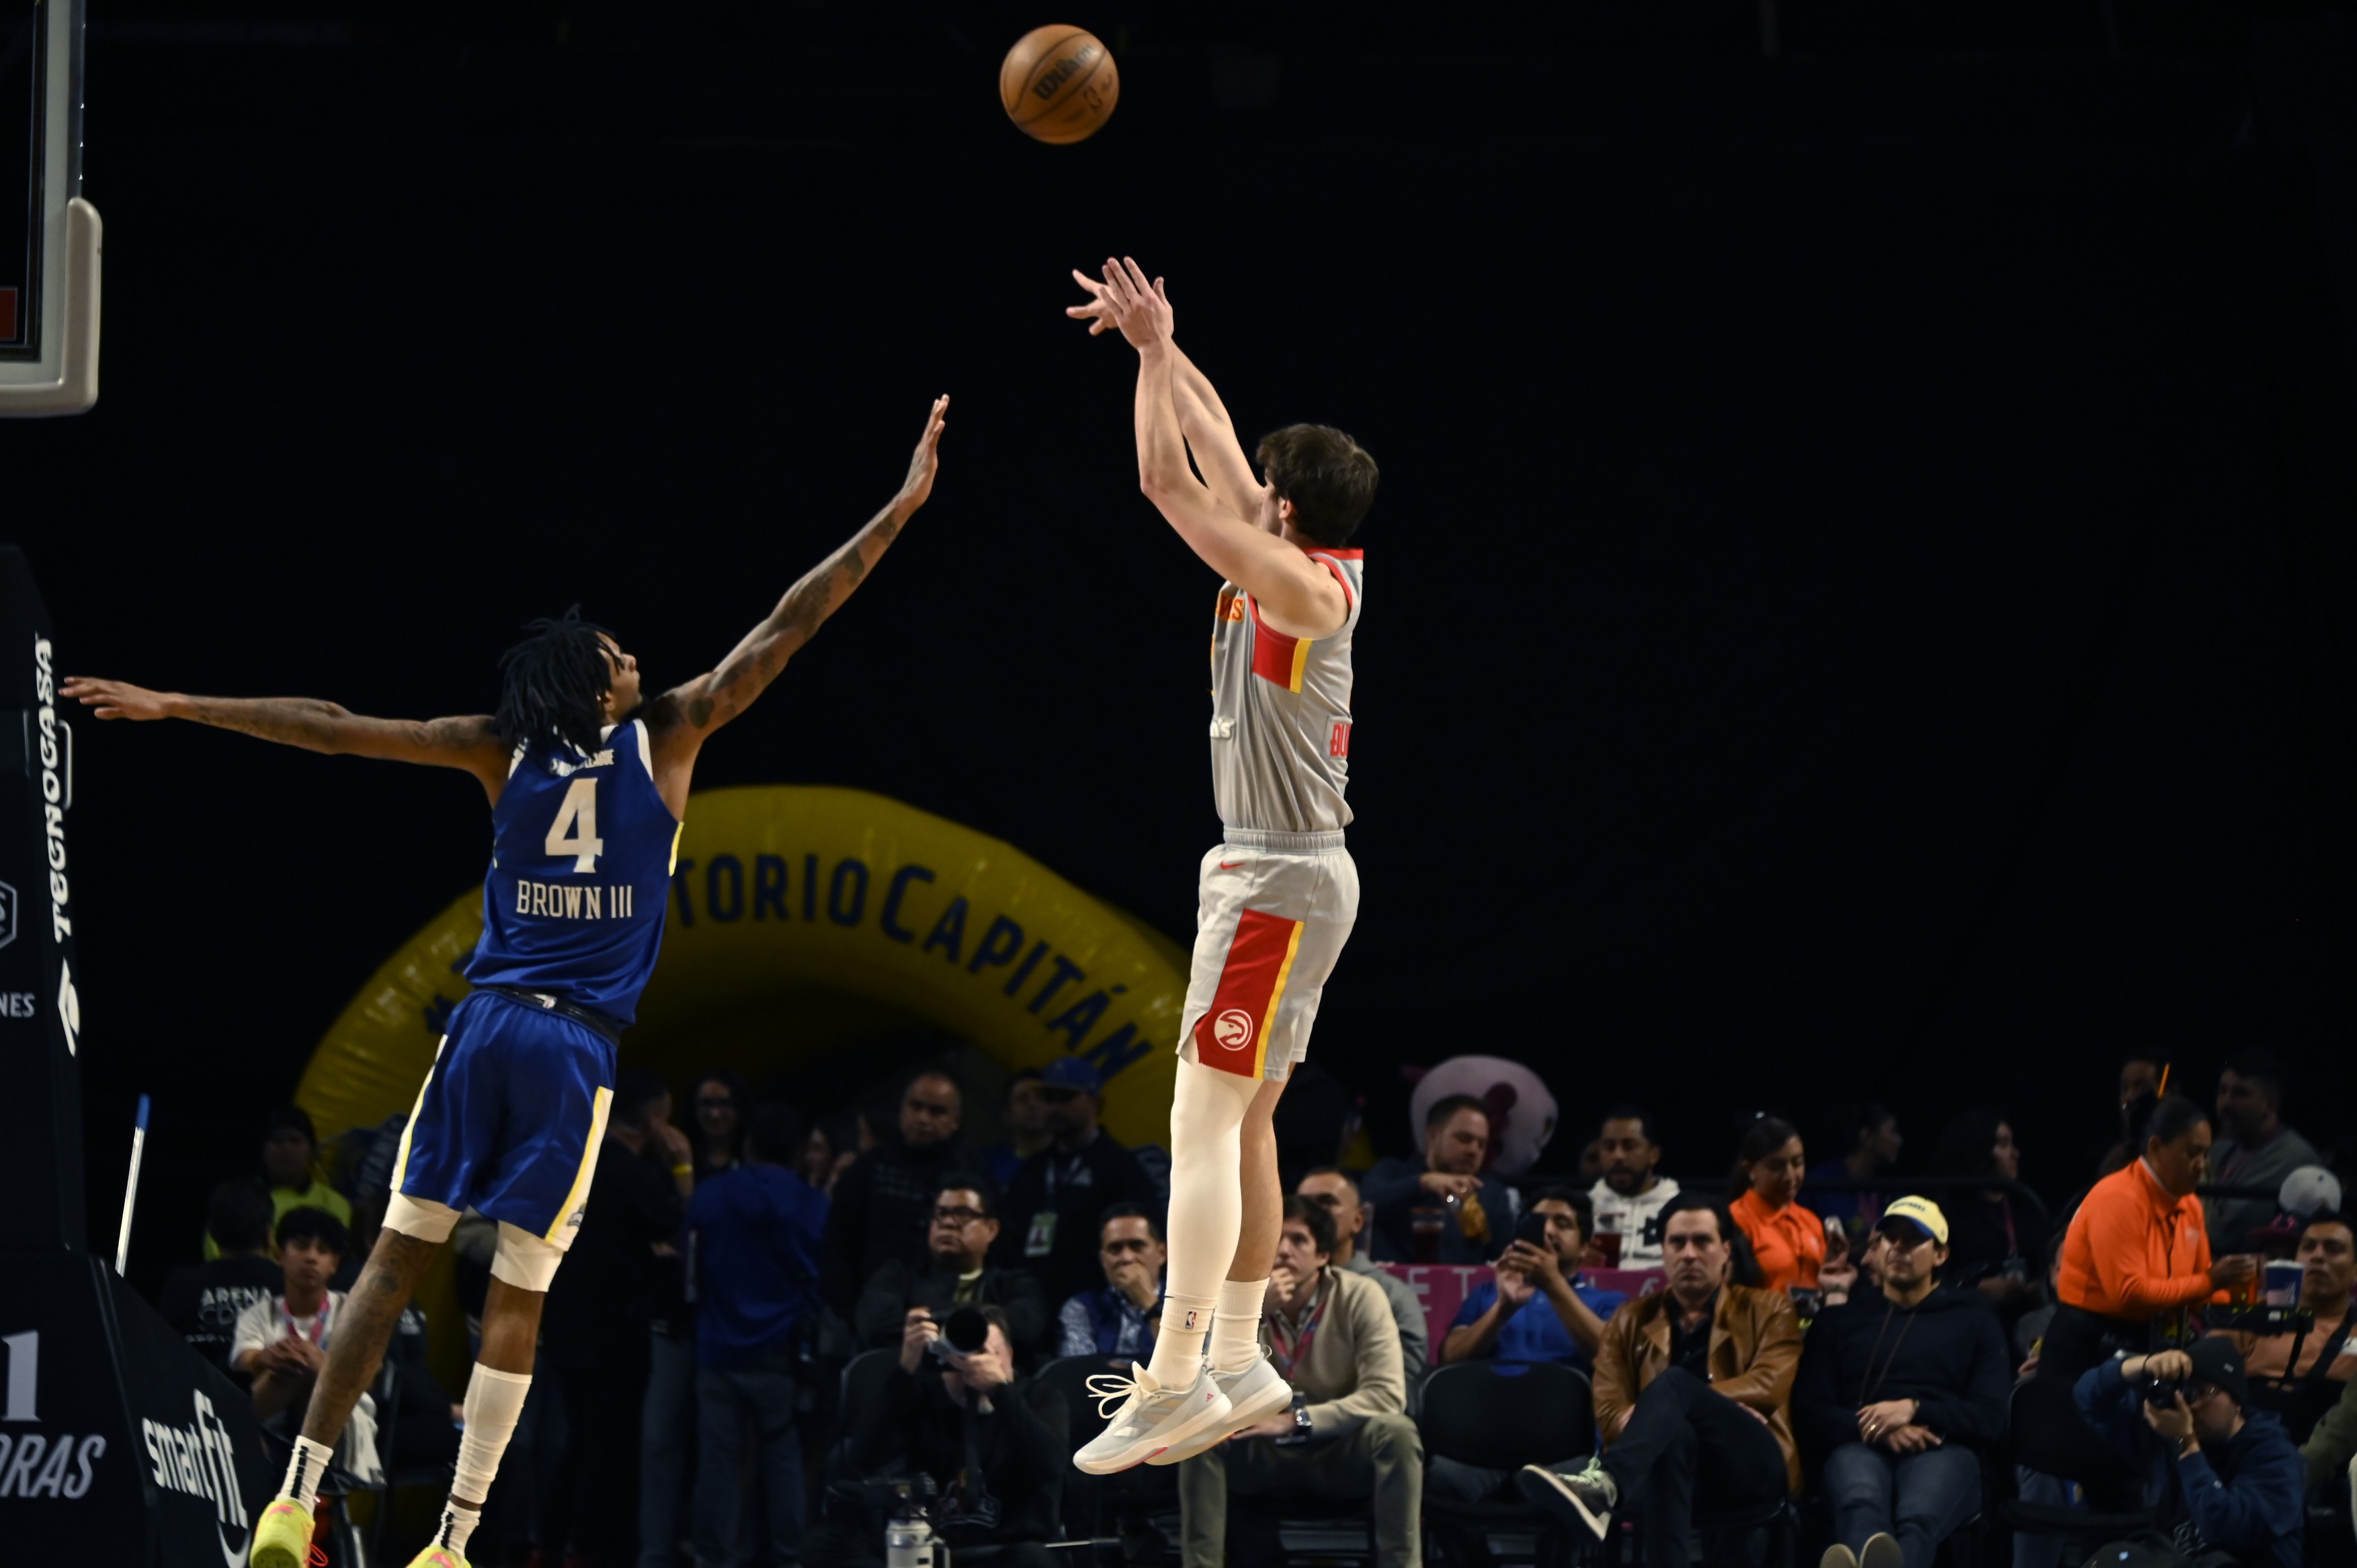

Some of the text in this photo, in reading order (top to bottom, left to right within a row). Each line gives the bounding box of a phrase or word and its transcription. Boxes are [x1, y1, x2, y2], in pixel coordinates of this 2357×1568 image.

[545, 777, 604, 873] 4
[516, 880, 632, 920] BROWN III
